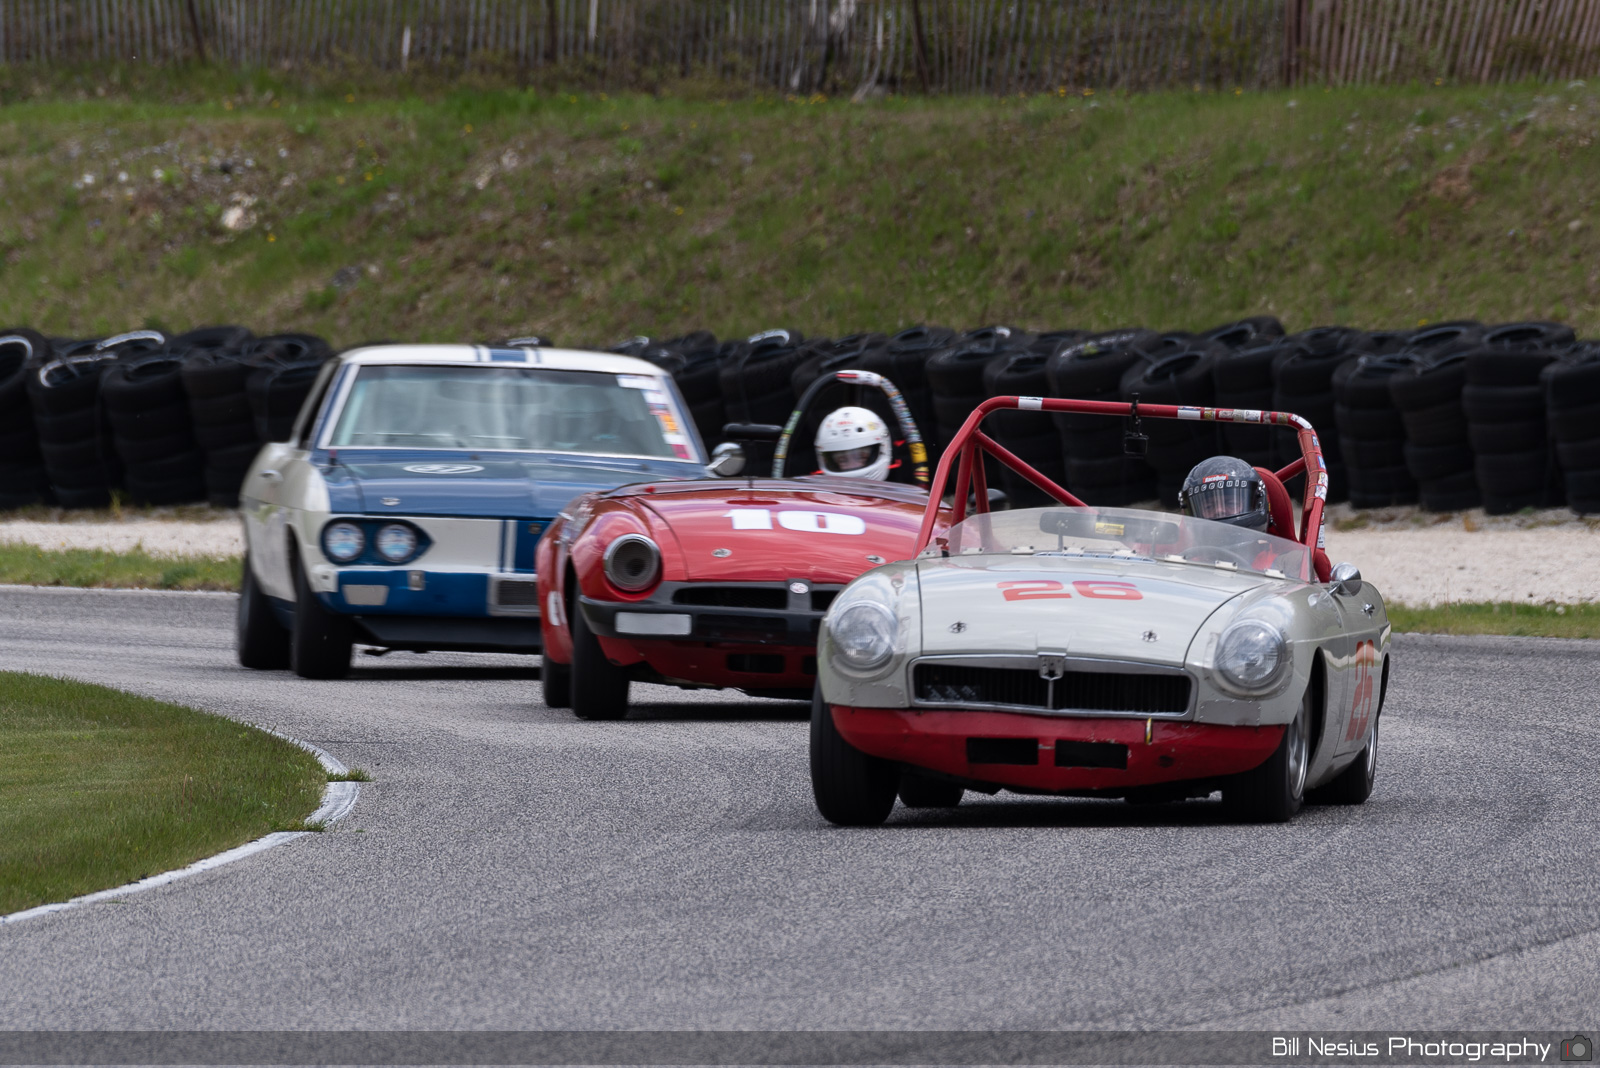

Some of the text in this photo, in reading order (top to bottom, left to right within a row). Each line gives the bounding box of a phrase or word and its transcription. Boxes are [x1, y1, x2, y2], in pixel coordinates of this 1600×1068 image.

[722, 508, 866, 535] 10
[996, 579, 1144, 602] 26
[1344, 639, 1375, 742] 26
